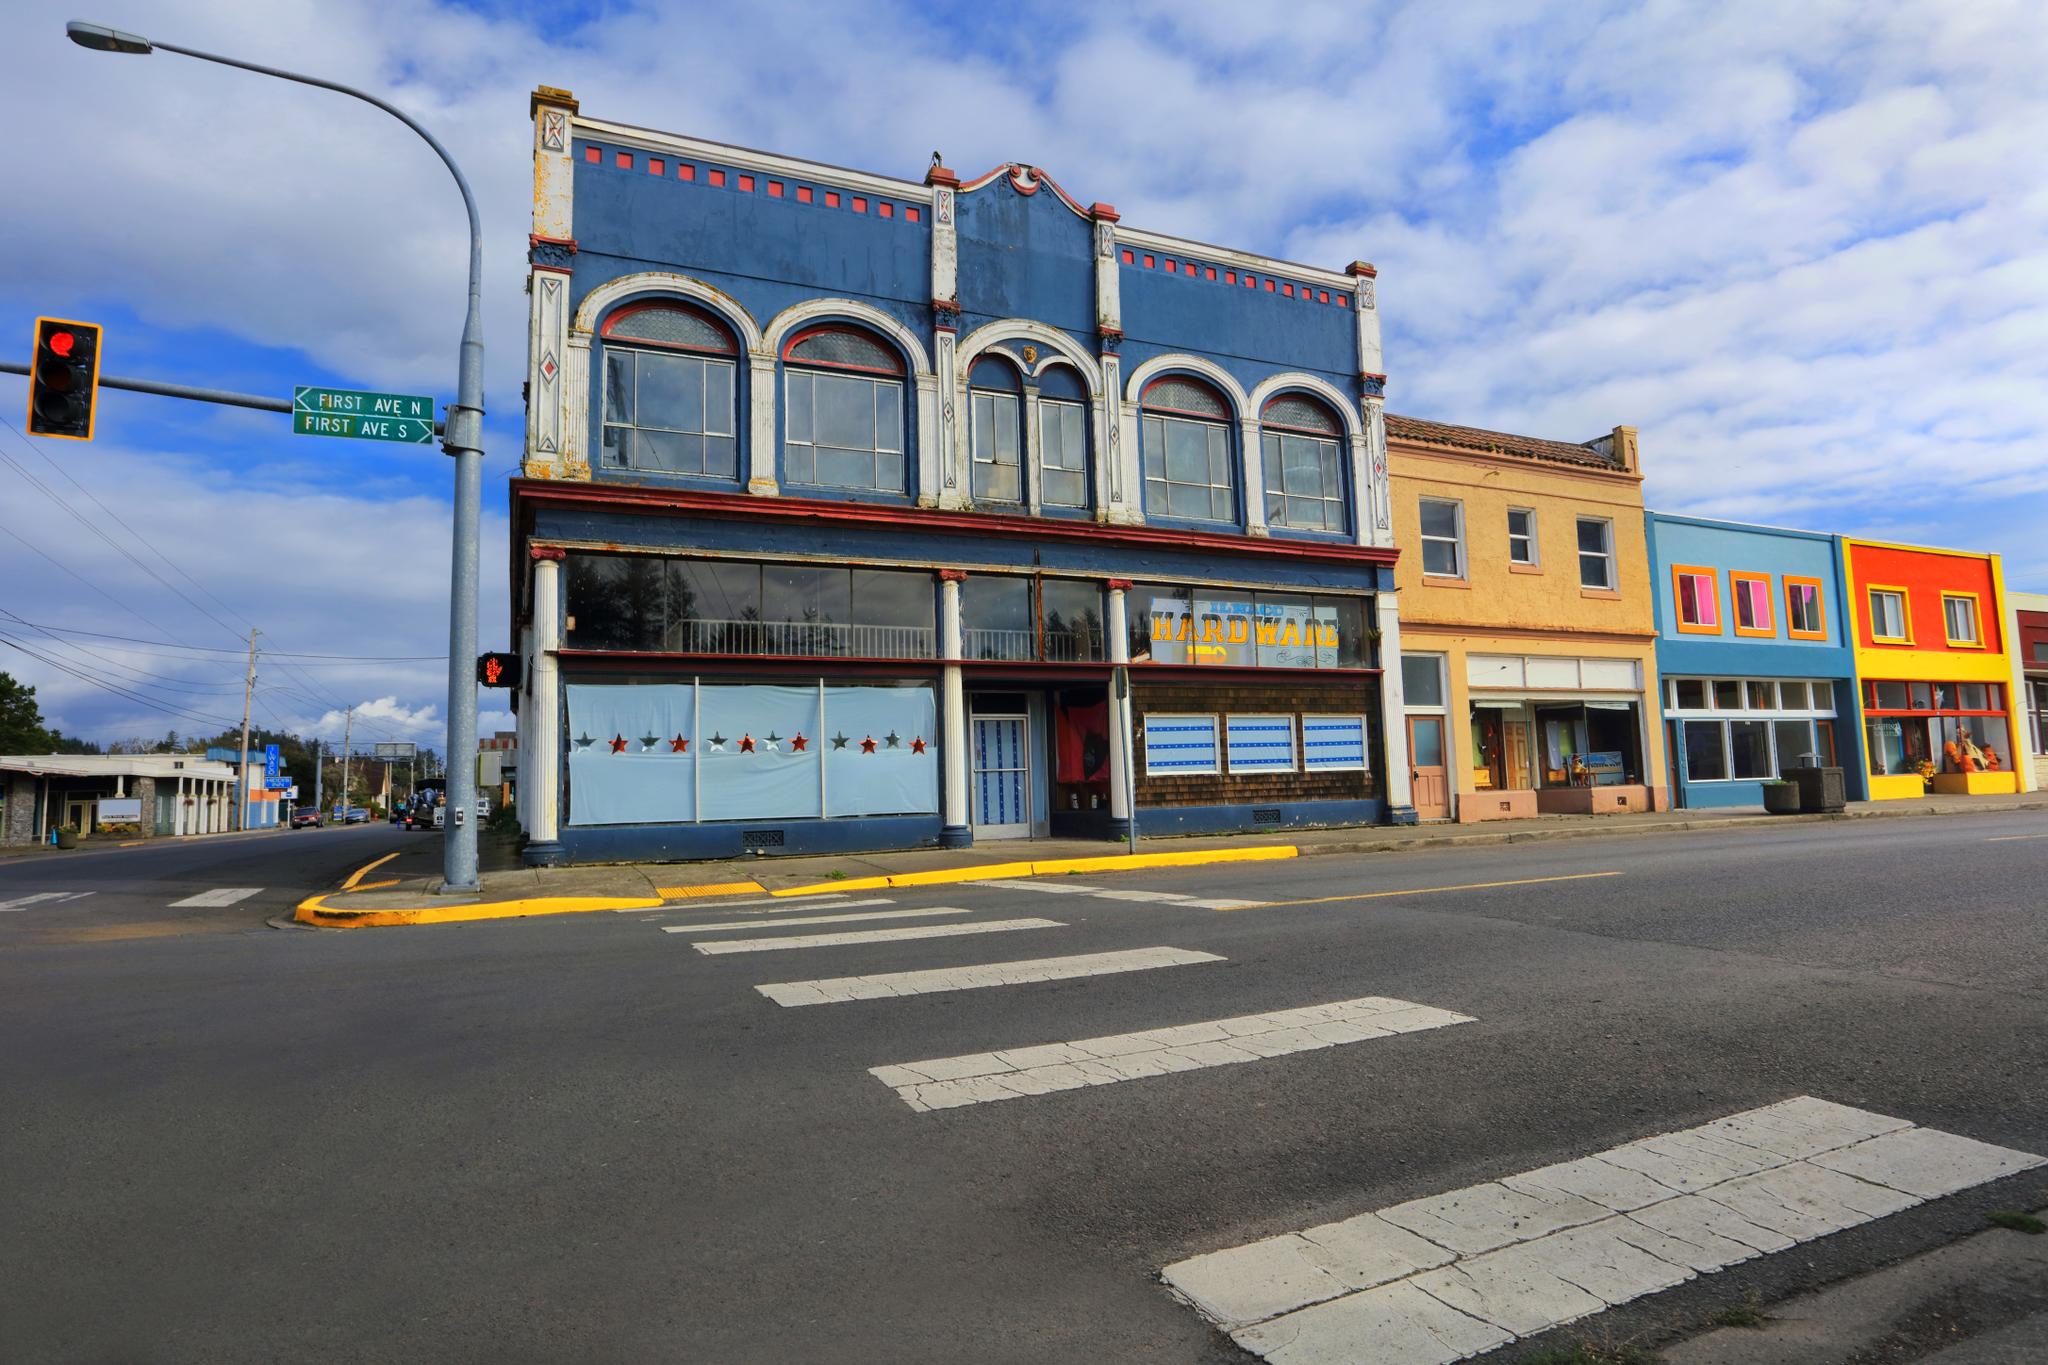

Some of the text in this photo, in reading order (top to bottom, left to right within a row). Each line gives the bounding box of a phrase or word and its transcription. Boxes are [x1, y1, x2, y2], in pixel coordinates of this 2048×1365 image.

[319, 393, 421, 415] FIRST AVE N
[305, 416, 408, 438] FIRST AVE S
[1150, 611, 1340, 648] HARDWARE
